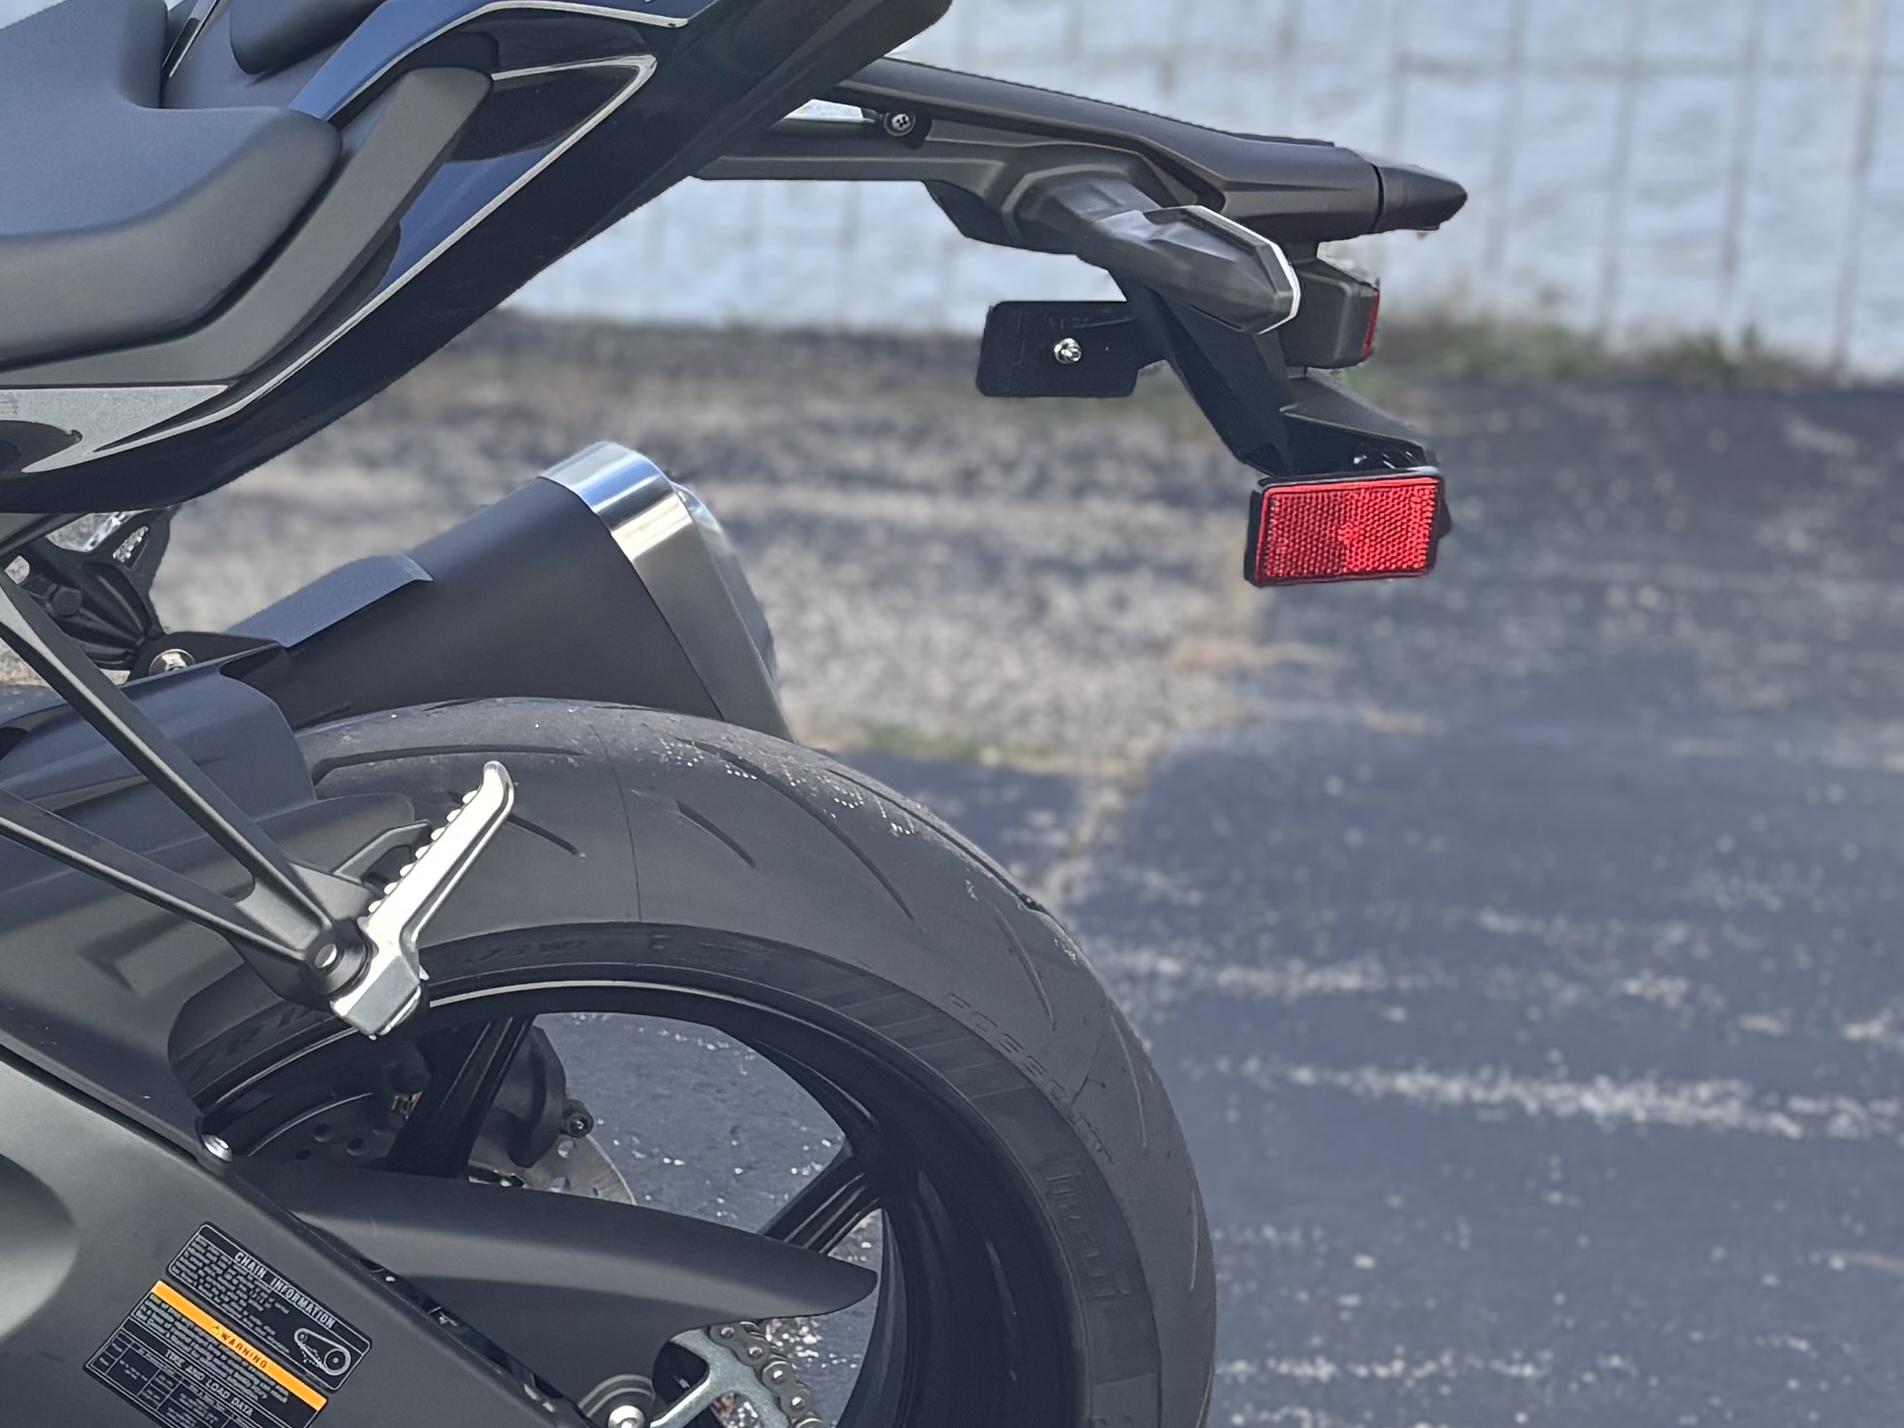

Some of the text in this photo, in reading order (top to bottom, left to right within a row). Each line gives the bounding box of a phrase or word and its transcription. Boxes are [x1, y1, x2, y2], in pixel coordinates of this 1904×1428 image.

[234, 1252, 336, 1328] CHAIN INFORMATION
[220, 1332, 268, 1369] WARNING
[205, 1378, 230, 1400] LOAD
[230, 1398, 254, 1417] DATA
